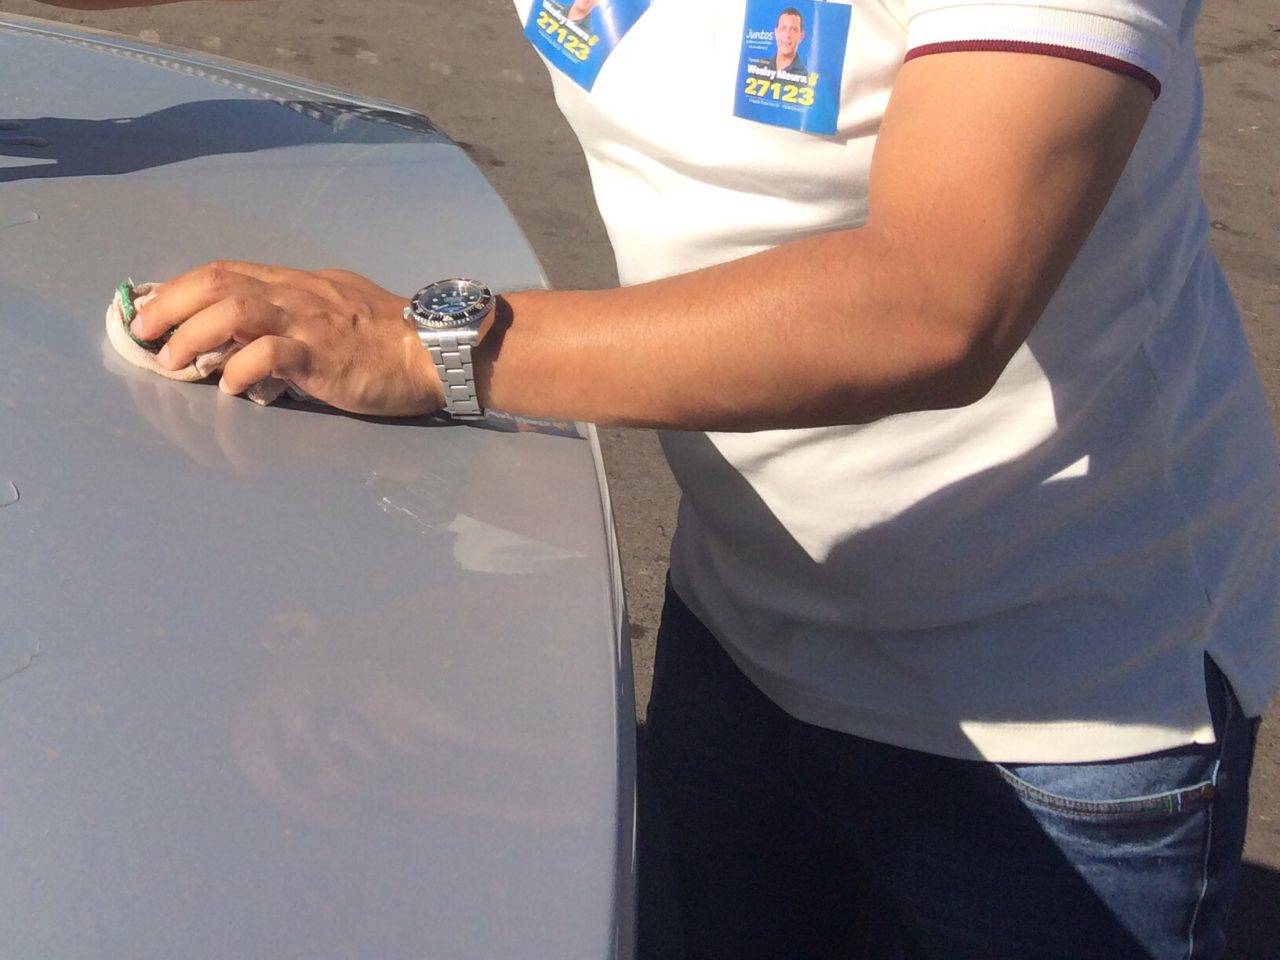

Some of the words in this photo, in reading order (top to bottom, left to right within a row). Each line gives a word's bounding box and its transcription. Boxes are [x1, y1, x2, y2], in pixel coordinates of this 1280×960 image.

[536, 11, 591, 61] 27123
[745, 29, 774, 41] Juntos
[747, 64, 776, 80] Wesley
[745, 77, 815, 106] 27123
